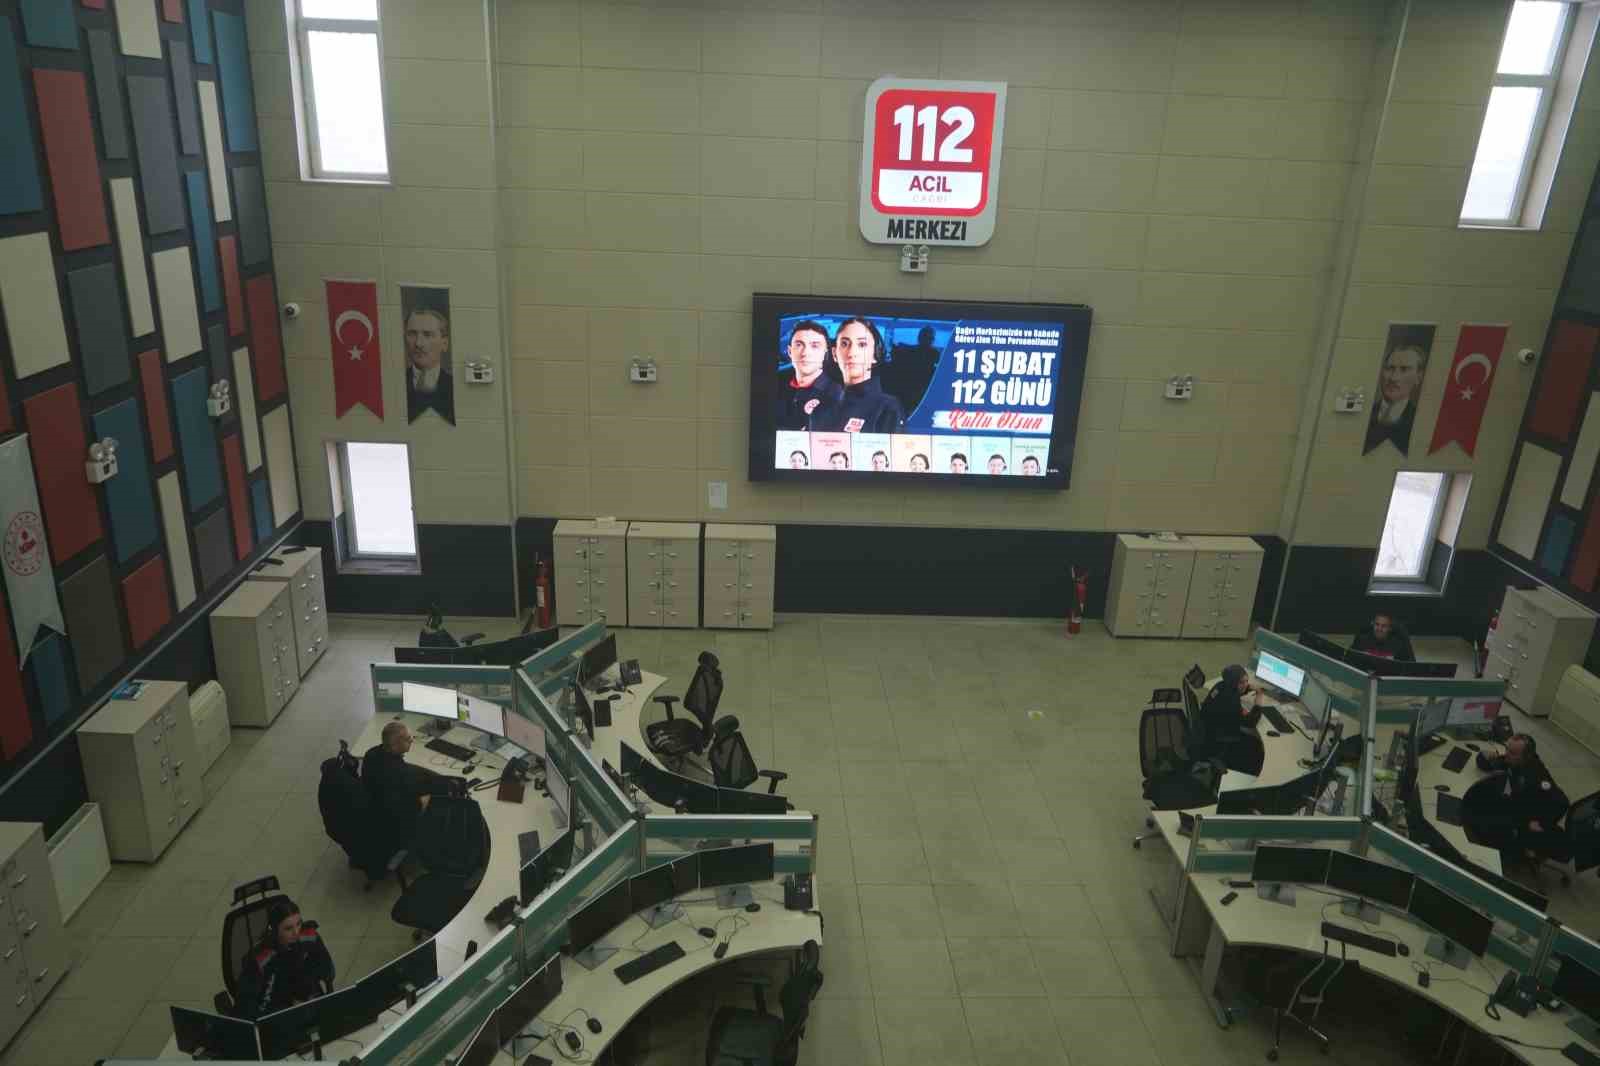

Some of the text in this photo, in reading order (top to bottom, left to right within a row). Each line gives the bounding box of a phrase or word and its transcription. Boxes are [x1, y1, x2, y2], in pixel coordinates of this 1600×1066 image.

[894, 104, 975, 163] 112
[953, 349, 1056, 378] 11 ŞUBAT
[951, 377, 1052, 406] 112 GÜNÜ
